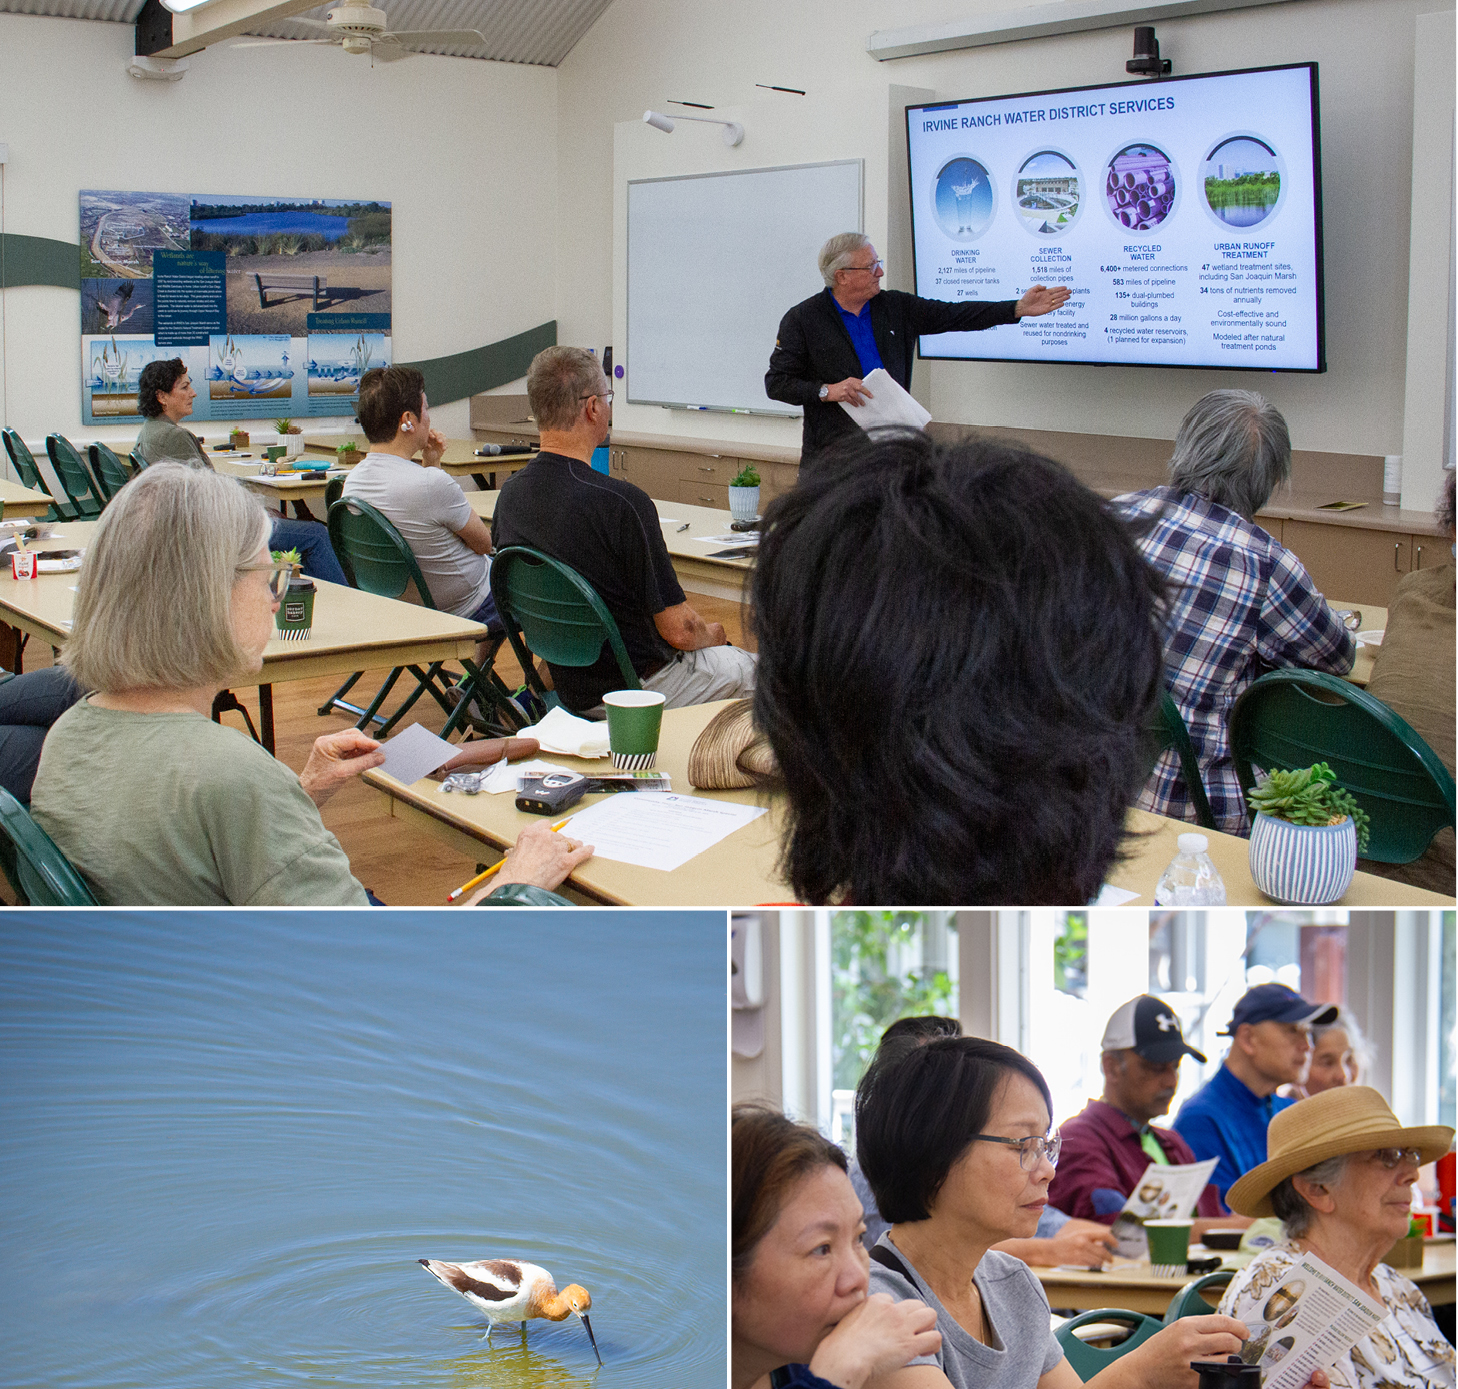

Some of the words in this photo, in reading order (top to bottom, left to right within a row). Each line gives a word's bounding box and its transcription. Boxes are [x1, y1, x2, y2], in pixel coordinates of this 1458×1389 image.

[922, 118, 958, 132] IRVINE
[961, 114, 1001, 128] RANCH
[1004, 110, 1045, 124] WATER
[1050, 104, 1105, 121] DISTRICT
[1109, 97, 1175, 114] SERVICES
[1123, 244, 1162, 252] RECYCLED
[1213, 243, 1241, 251] URBAN
[1243, 242, 1275, 250] RUNOFF
[1039, 247, 1063, 255] SEWER
[1221, 251, 1268, 259] TREATMENT
[975, 267, 996, 275] pipeline
[1032, 266, 1048, 274] 1,518
[1100, 265, 1121, 273] 6,400+
[1149, 264, 1188, 272] connections
[1274, 263, 1293, 271] sites,
[1058, 275, 1074, 283] pipes
[1199, 273, 1228, 281] including
[1245, 273, 1273, 281] Joaquin
[1274, 272, 1297, 280] Marsh
[1151, 278, 1176, 286] pipeline
[1115, 291, 1130, 299] 135+
[1131, 291, 1174, 300] dual-plumbed
[1130, 301, 1158, 309] buildings
[1233, 297, 1262, 305] annually
[1139, 314, 1162, 322] gallons
[1217, 310, 1264, 318] Cost-effective
[1265, 310, 1279, 318] and
[1210, 320, 1263, 328] environmentally
[1053, 330, 1087, 339] nondrinking
[1109, 327, 1135, 335] recycled
[1155, 328, 1188, 336] reservoirs,
[1115, 336, 1140, 344] planned
[1151, 337, 1186, 345] expansion)
[1243, 333, 1259, 341] after
[1221, 342, 1254, 350] treatment
[1255, 343, 1277, 351] ponds
